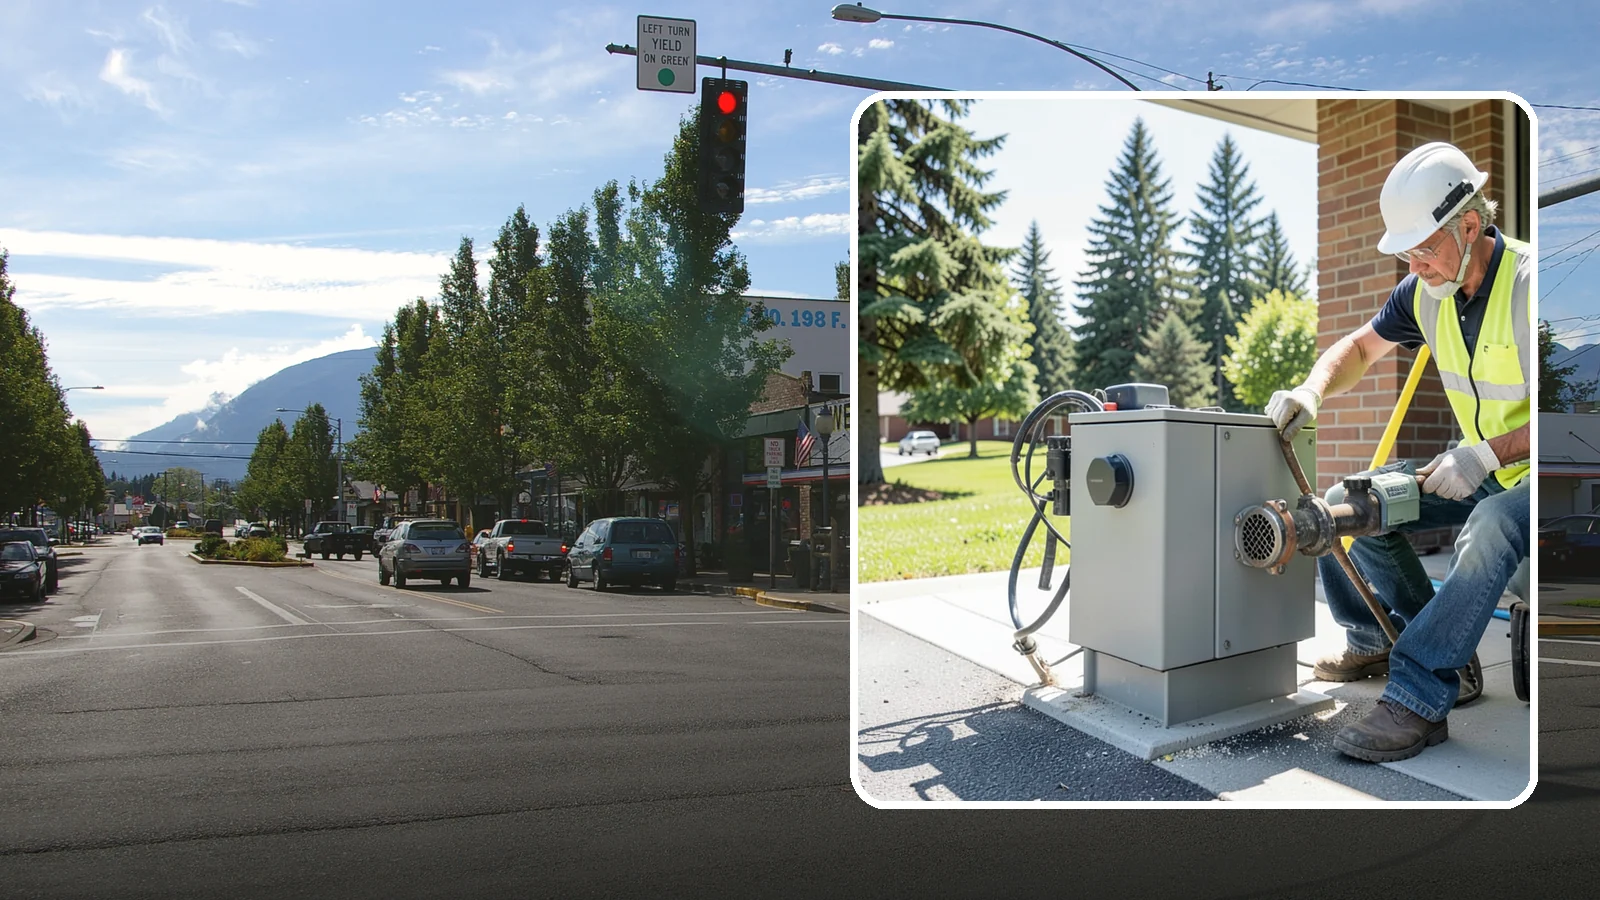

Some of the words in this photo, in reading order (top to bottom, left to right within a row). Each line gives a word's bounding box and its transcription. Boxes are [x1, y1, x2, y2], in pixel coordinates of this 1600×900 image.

[643, 24, 663, 34] LEFT
[668, 25, 690, 36] TURN
[652, 38, 681, 51] YIELD
[644, 54, 656, 63] ON
[661, 55, 689, 65] GREEN
[791, 310, 825, 328] 198
[831, 311, 846, 328] F.
